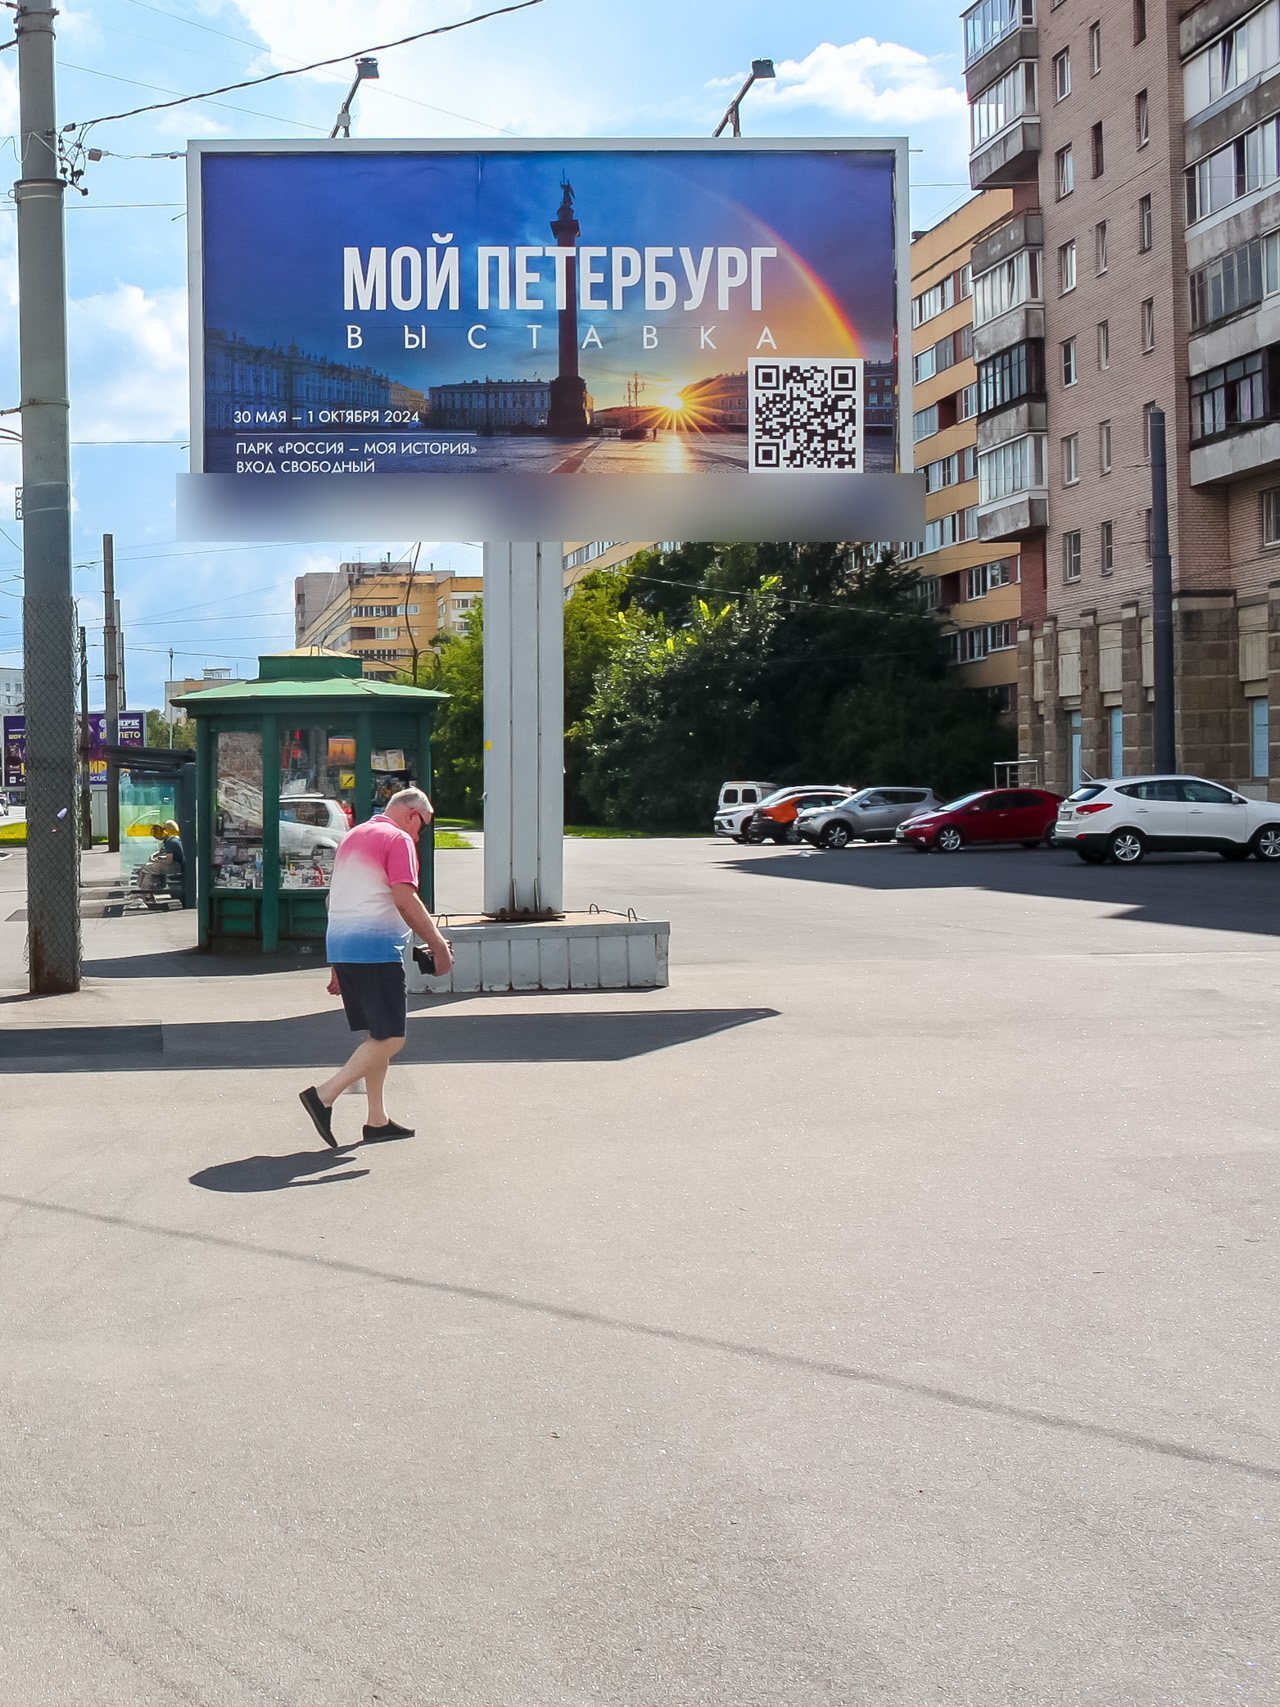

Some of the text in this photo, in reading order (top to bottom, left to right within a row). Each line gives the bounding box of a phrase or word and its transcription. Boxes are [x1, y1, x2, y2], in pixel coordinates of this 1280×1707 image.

[343, 232, 778, 311] МОЙ ПЕТЕРБУРГ
[346, 324, 778, 350] ВЫСТАВКА
[233, 410, 251, 424] 30
[255, 411, 287, 423] МАЯ
[307, 410, 314, 423] 1
[318, 410, 380, 423] ОКТЯБРЯ
[384, 410, 420, 423] 2024
[236, 442, 274, 455] ПАРК
[277, 442, 345, 455] «РОССИЯ
[363, 442, 397, 455] МОЯ
[401, 442, 478, 455] ИСТОРИЯ»
[236, 458, 376, 474] ВХОД СВОБОДНЫЙ
